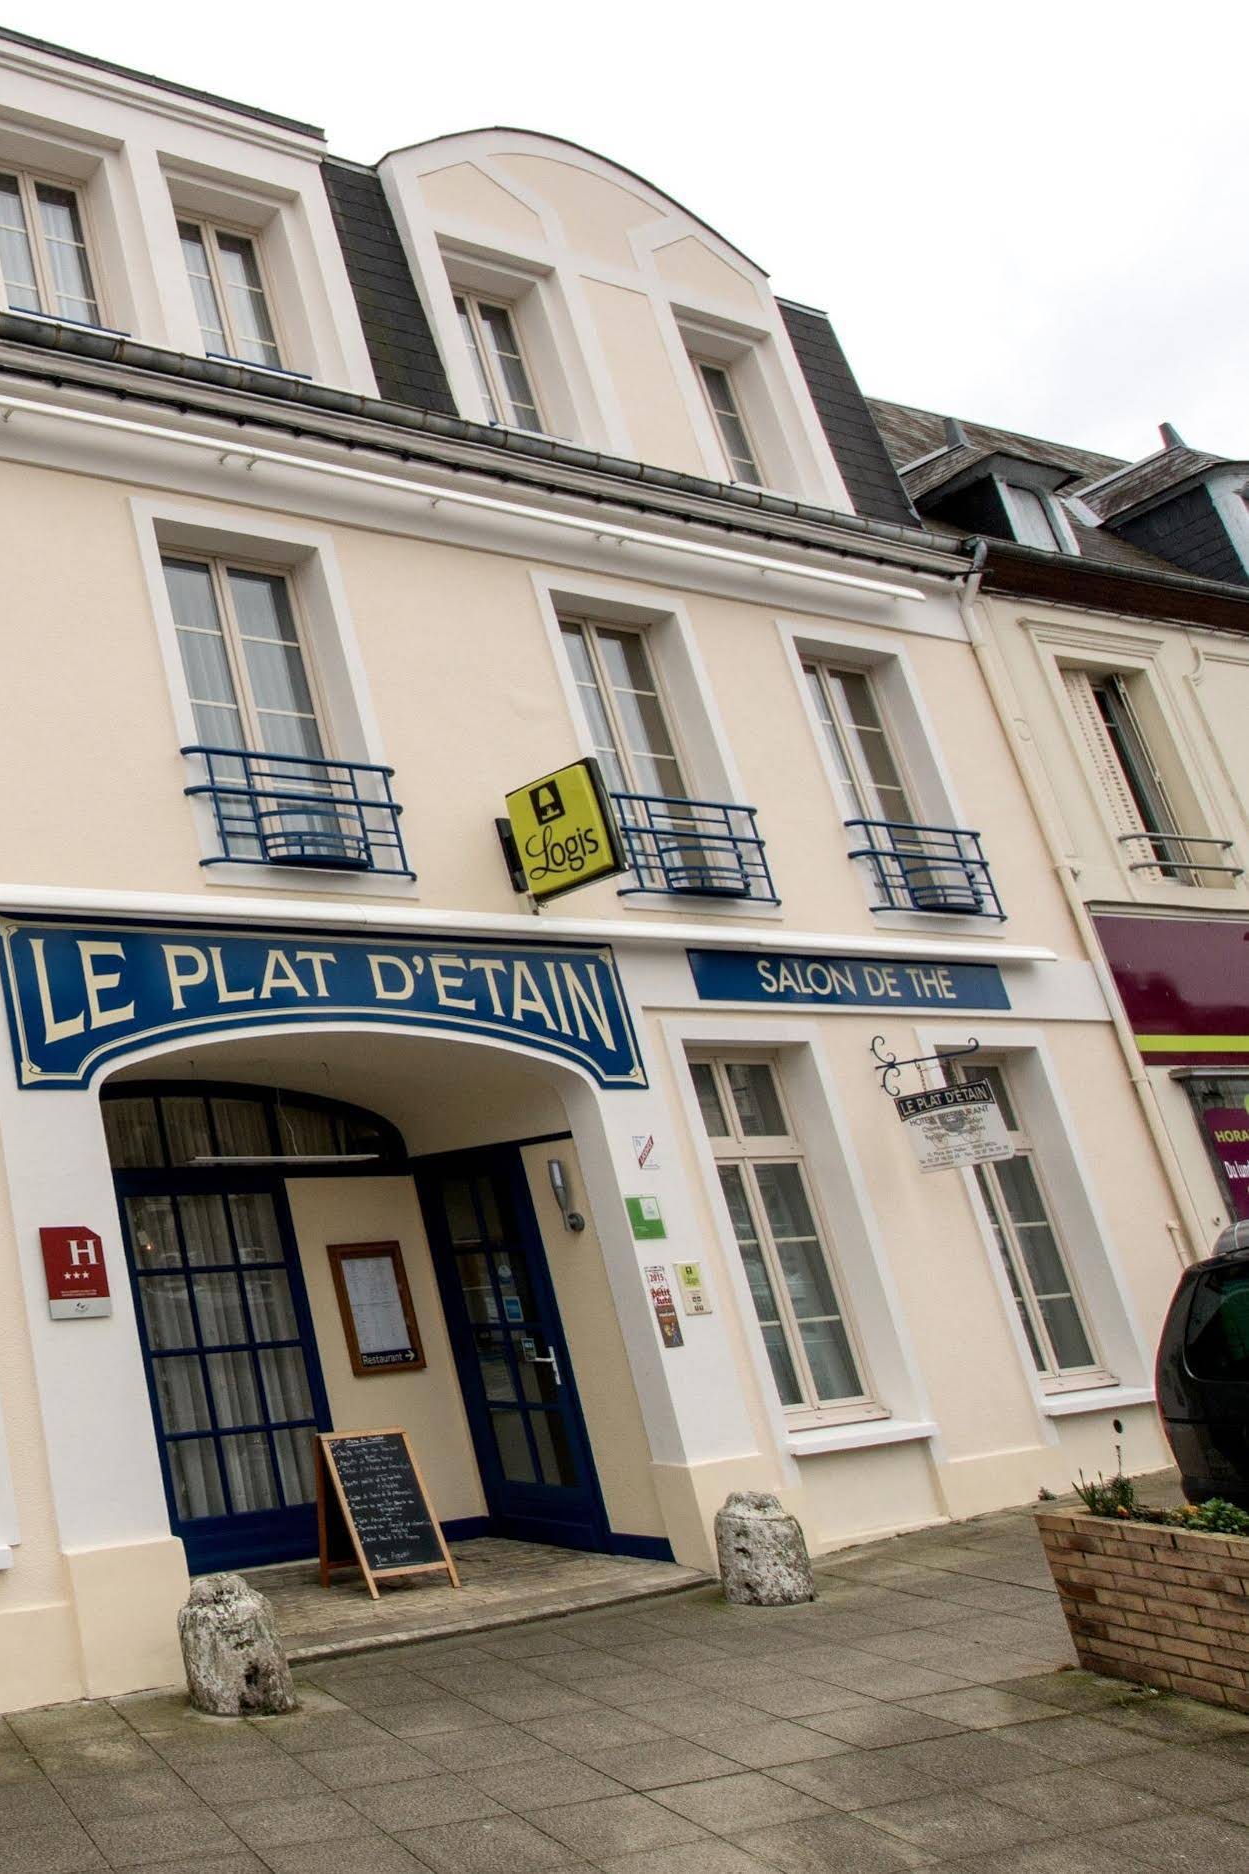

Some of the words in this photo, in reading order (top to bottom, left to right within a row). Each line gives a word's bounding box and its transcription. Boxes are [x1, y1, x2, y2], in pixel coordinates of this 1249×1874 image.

[525, 825, 599, 880] Logis
[29, 938, 135, 1045] LE
[161, 943, 337, 1010] PLAT
[756, 960, 857, 996] SALON
[862, 966, 902, 997] DE
[900, 1101, 917, 1116] LE
[917, 1094, 943, 1110] PLAT
[65, 1239, 100, 1266] H
[362, 1352, 403, 1366] Restaurant
